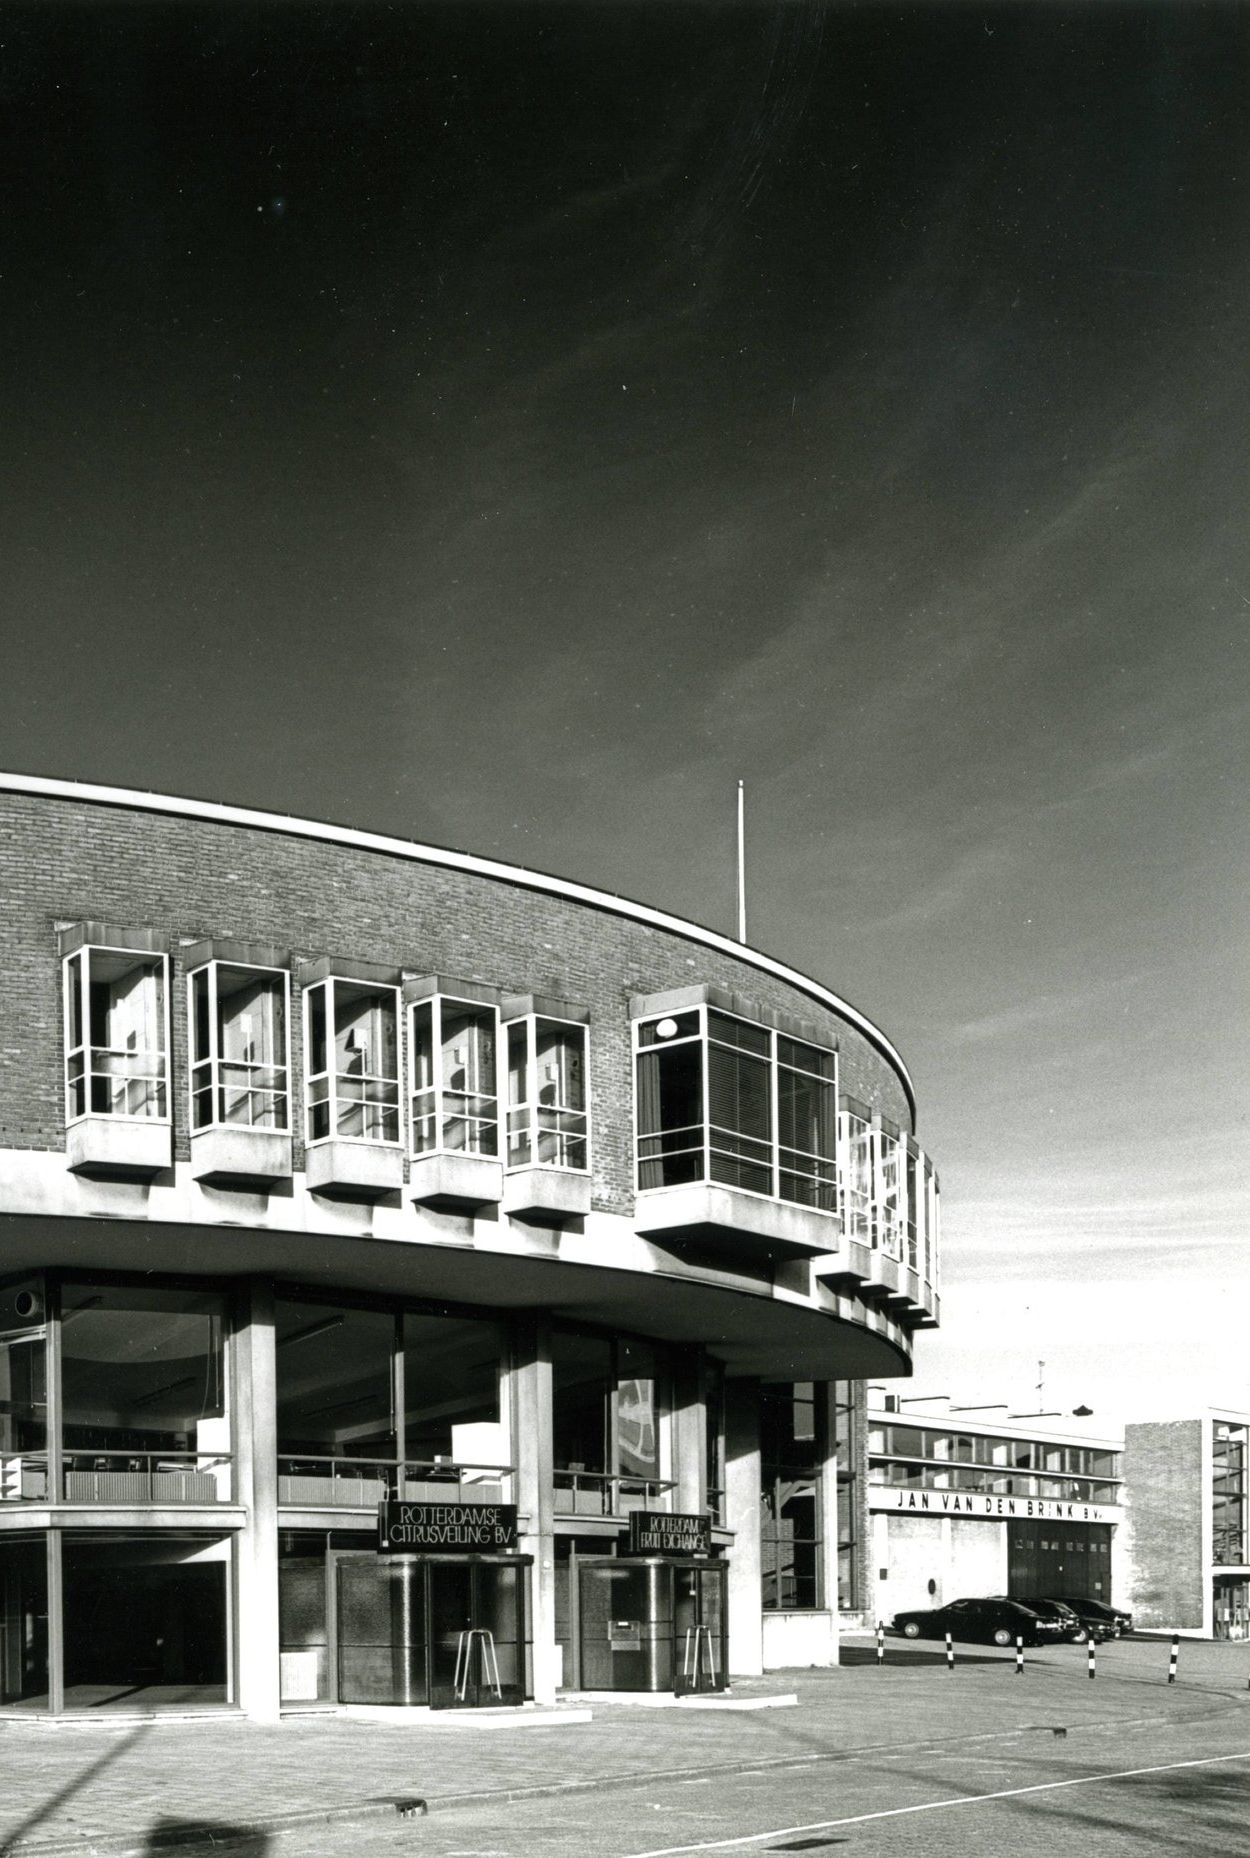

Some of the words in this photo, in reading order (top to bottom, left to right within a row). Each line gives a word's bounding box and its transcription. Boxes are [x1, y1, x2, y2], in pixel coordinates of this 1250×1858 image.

[897, 1491, 929, 1509] JAN
[941, 1494, 973, 1511] VAN
[985, 1497, 1015, 1514] DEN
[1027, 1500, 1073, 1517] BRINK
[400, 1505, 502, 1526] ROTTERDAMSE
[649, 1516, 699, 1534] ROTTERDAM
[390, 1524, 491, 1544] CITRUSVEILING
[494, 1527, 512, 1544] BV
[640, 1531, 661, 1549] FRUIT
[663, 1532, 707, 1551] EXCHANGE
